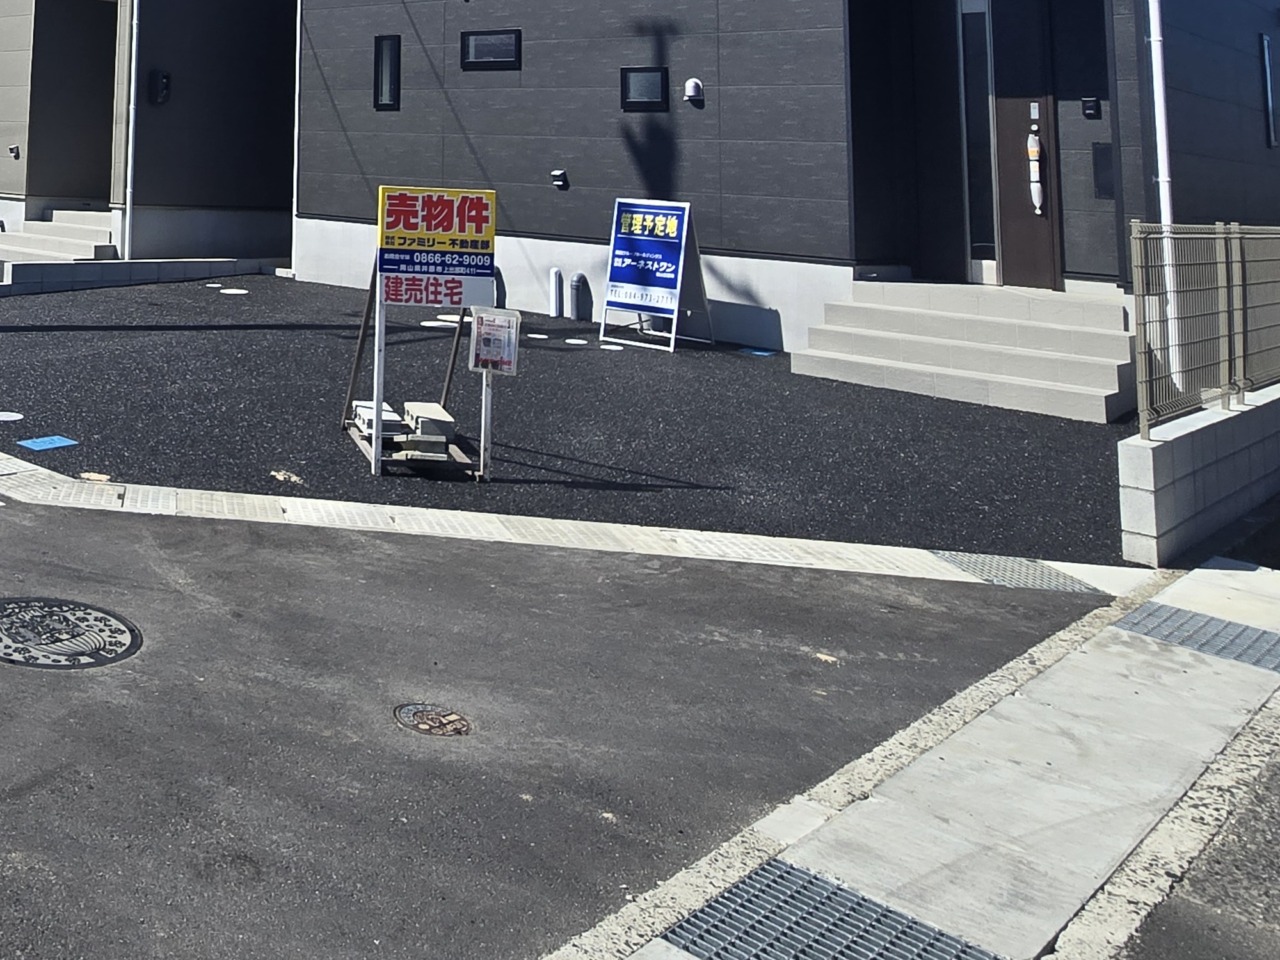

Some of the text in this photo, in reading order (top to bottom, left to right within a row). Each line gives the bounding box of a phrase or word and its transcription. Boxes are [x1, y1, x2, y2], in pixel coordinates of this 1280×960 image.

[385, 193, 490, 235] 売物件
[397, 236, 446, 248] ファミリー
[413, 252, 491, 266] 0866-62-9009
[622, 258, 676, 272] アーネストワン
[384, 275, 463, 305] 建売住宅
